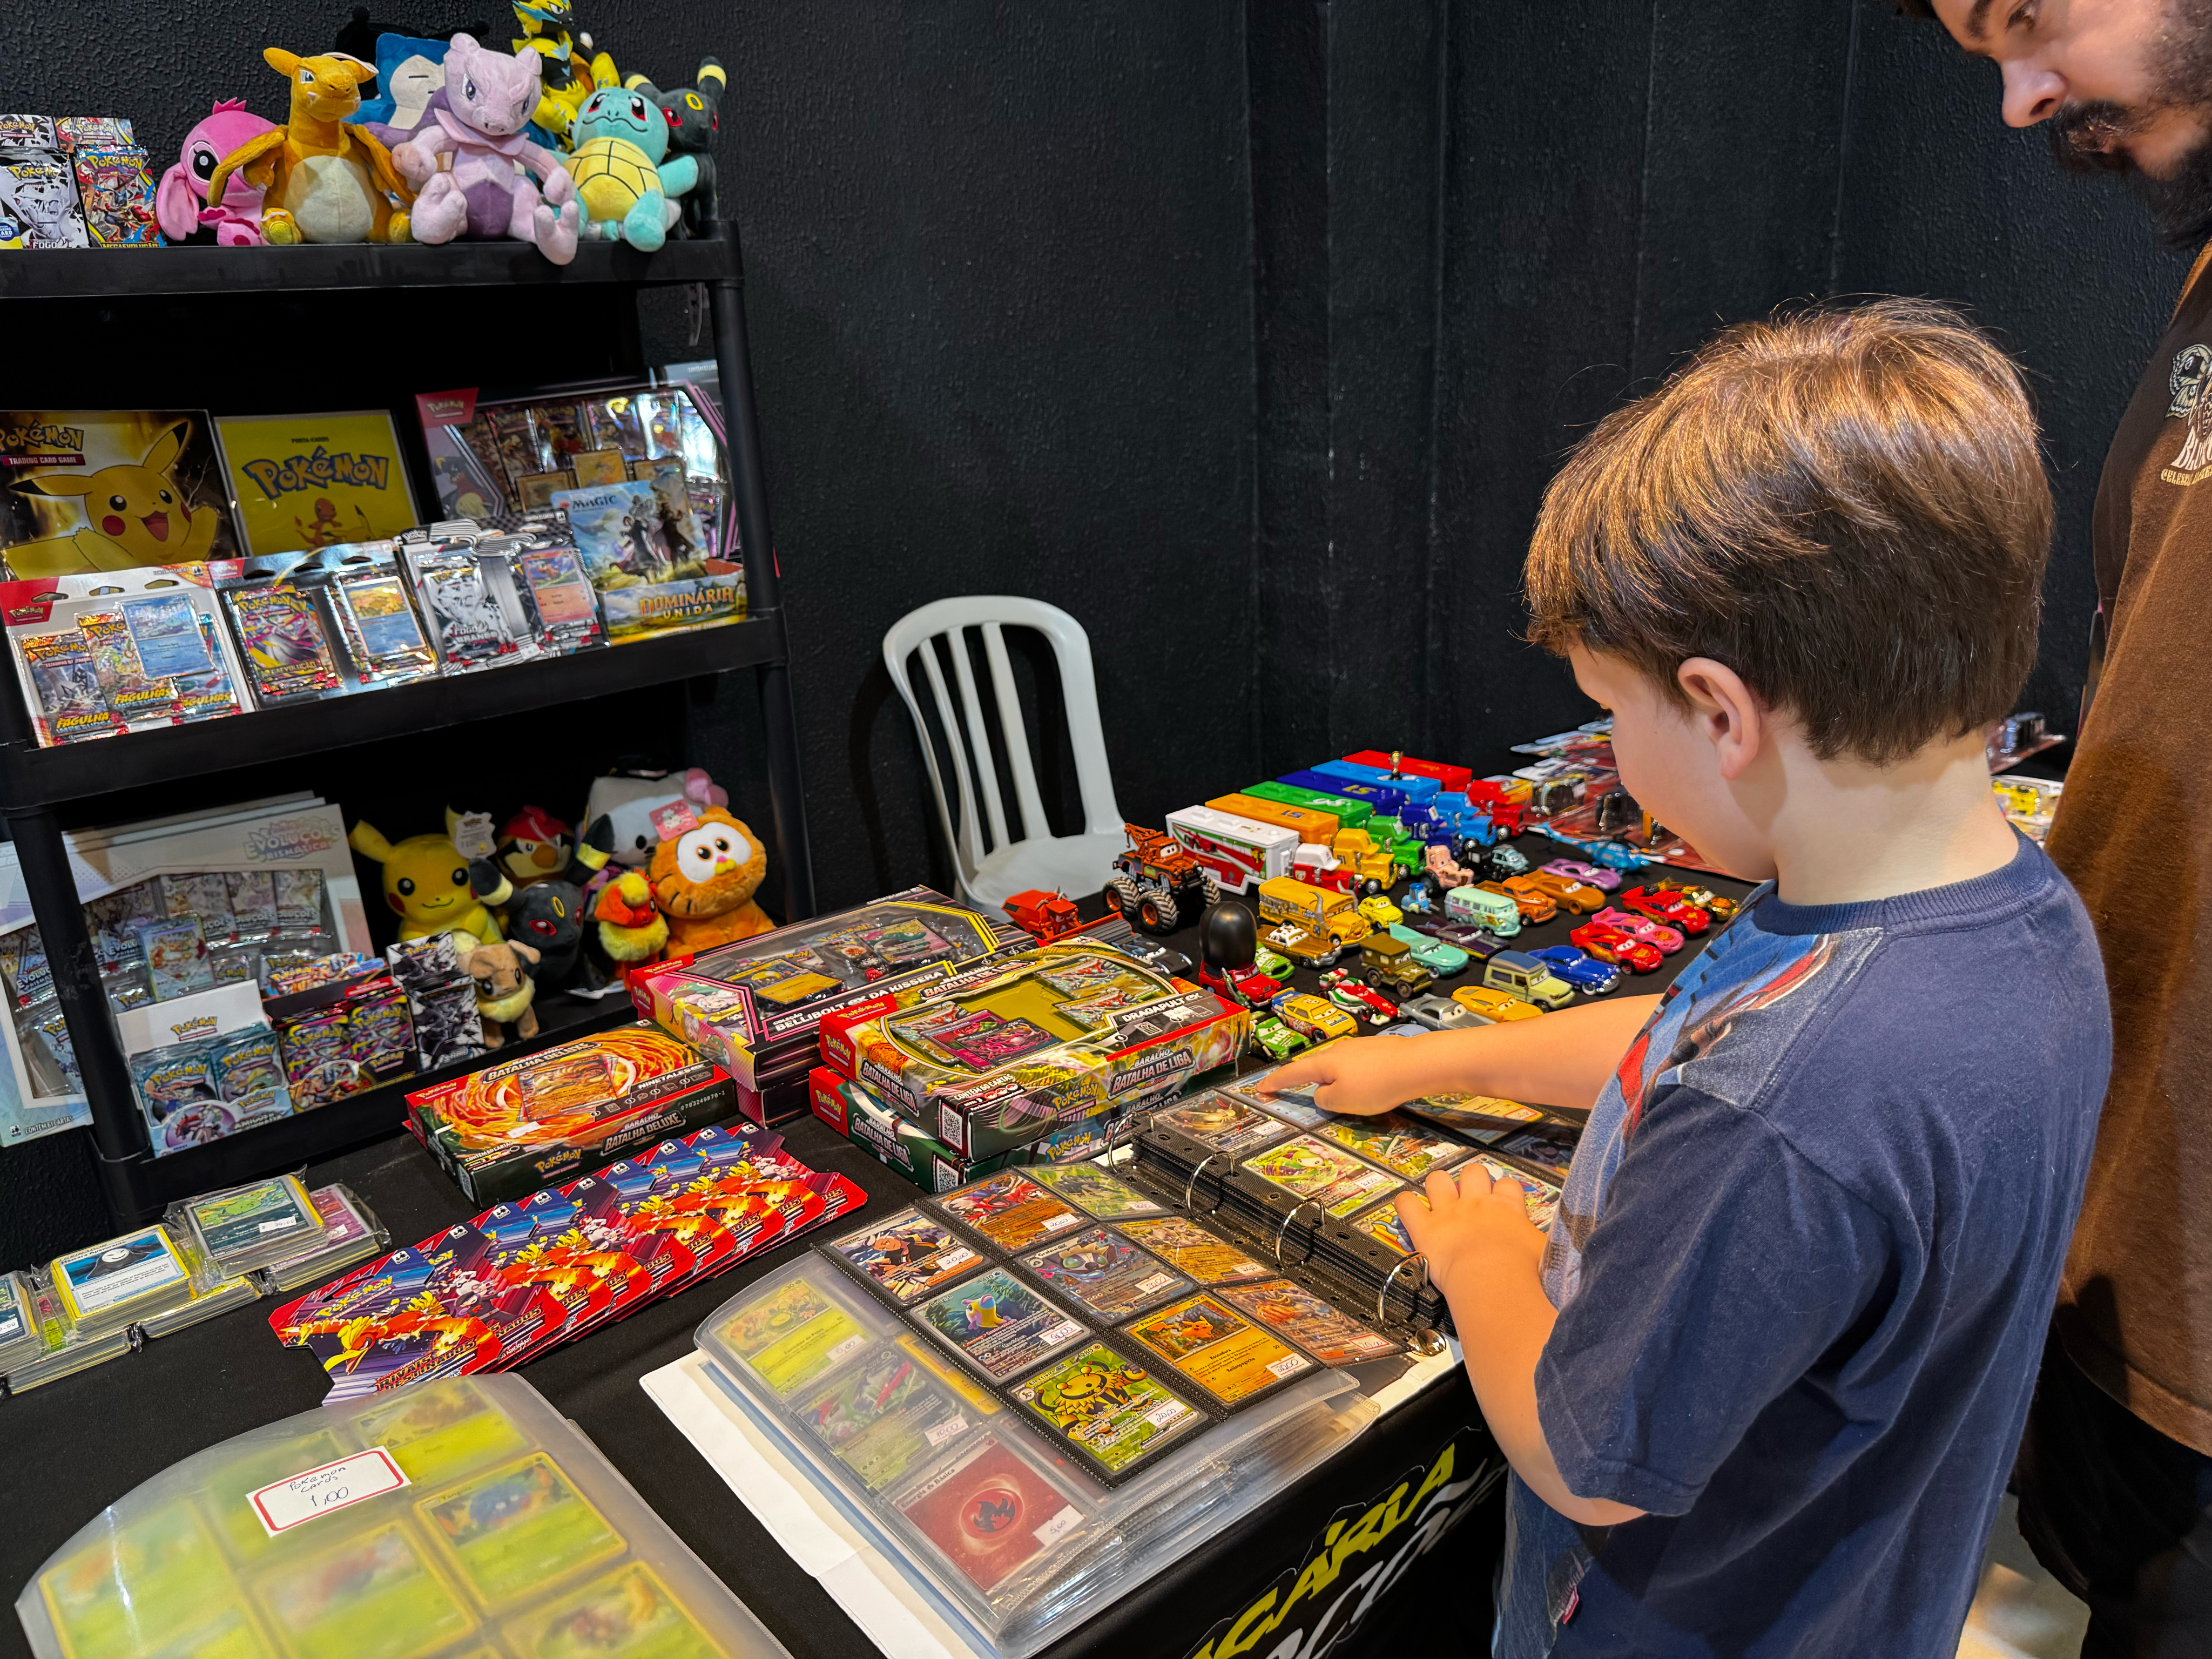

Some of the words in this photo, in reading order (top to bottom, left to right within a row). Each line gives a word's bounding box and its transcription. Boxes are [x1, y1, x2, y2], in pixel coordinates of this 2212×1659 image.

[9, 457, 38, 465] TRADING
[572, 494, 617, 510] MAGIC
[639, 585, 735, 616] DOMINÁRIA
[663, 604, 713, 620] UNIDA
[115, 687, 172, 704] FAGULHAS
[56, 711, 110, 728] FAGULHA
[924, 977, 973, 997] BATALHA
[775, 1001, 845, 1032] BELLIBOLT
[869, 986, 889, 1000] DA
[889, 971, 944, 994] KISSERA
[1121, 996, 1185, 1023] DRAGAPULT
[772, 1012, 803, 1026] COLEÇÃO
[488, 1055, 555, 1080] BATALHA
[554, 1042, 594, 1060] DELUXE
[1134, 1048, 1171, 1067] BARALHO
[638, 1069, 689, 1090] NINETALES
[877, 1062, 902, 1082] BARALHO
[1112, 1065, 1156, 1094] BATALHA
[1156, 1059, 1169, 1074] DE
[1169, 1051, 1192, 1069] LIGA
[862, 1062, 891, 1094] BATALHA
[891, 1085, 901, 1100] DE
[900, 1090, 918, 1112] LIGA
[954, 1087, 982, 1101] CONTÉM
[980, 1083, 991, 1091] 60
[988, 1074, 1014, 1088] CARTAS
[624, 1112, 659, 1131] BARALHO
[869, 1116, 896, 1138] BARALHO
[604, 1125, 648, 1152] BATALHA
[647, 1111, 683, 1134] DELUXE
[493, 1142, 514, 1152] CARTAS
[854, 1117, 884, 1148] BATALHA
[884, 1139, 894, 1154] DE
[893, 1145, 910, 1168] LIGA
[1364, 1211, 1381, 1222] Palafin
[837, 1236, 861, 1248] Drayton
[1037, 1245, 1059, 1259] Grafaiai
[929, 1294, 953, 1307] Bruxish
[1191, 1298, 1200, 1306] 70
[1139, 1315, 1162, 1327] Pikachu
[505, 1337, 532, 1355] ADICIONAIS
[1080, 1347, 1094, 1359] 280
[377, 1354, 432, 1391] RIVAIS
[1028, 1366, 1055, 1387] Electivire
[309, 1486, 349, 1507] 1,00
[900, 1488, 928, 1510] Energia
[934, 1467, 956, 1487] Básica
